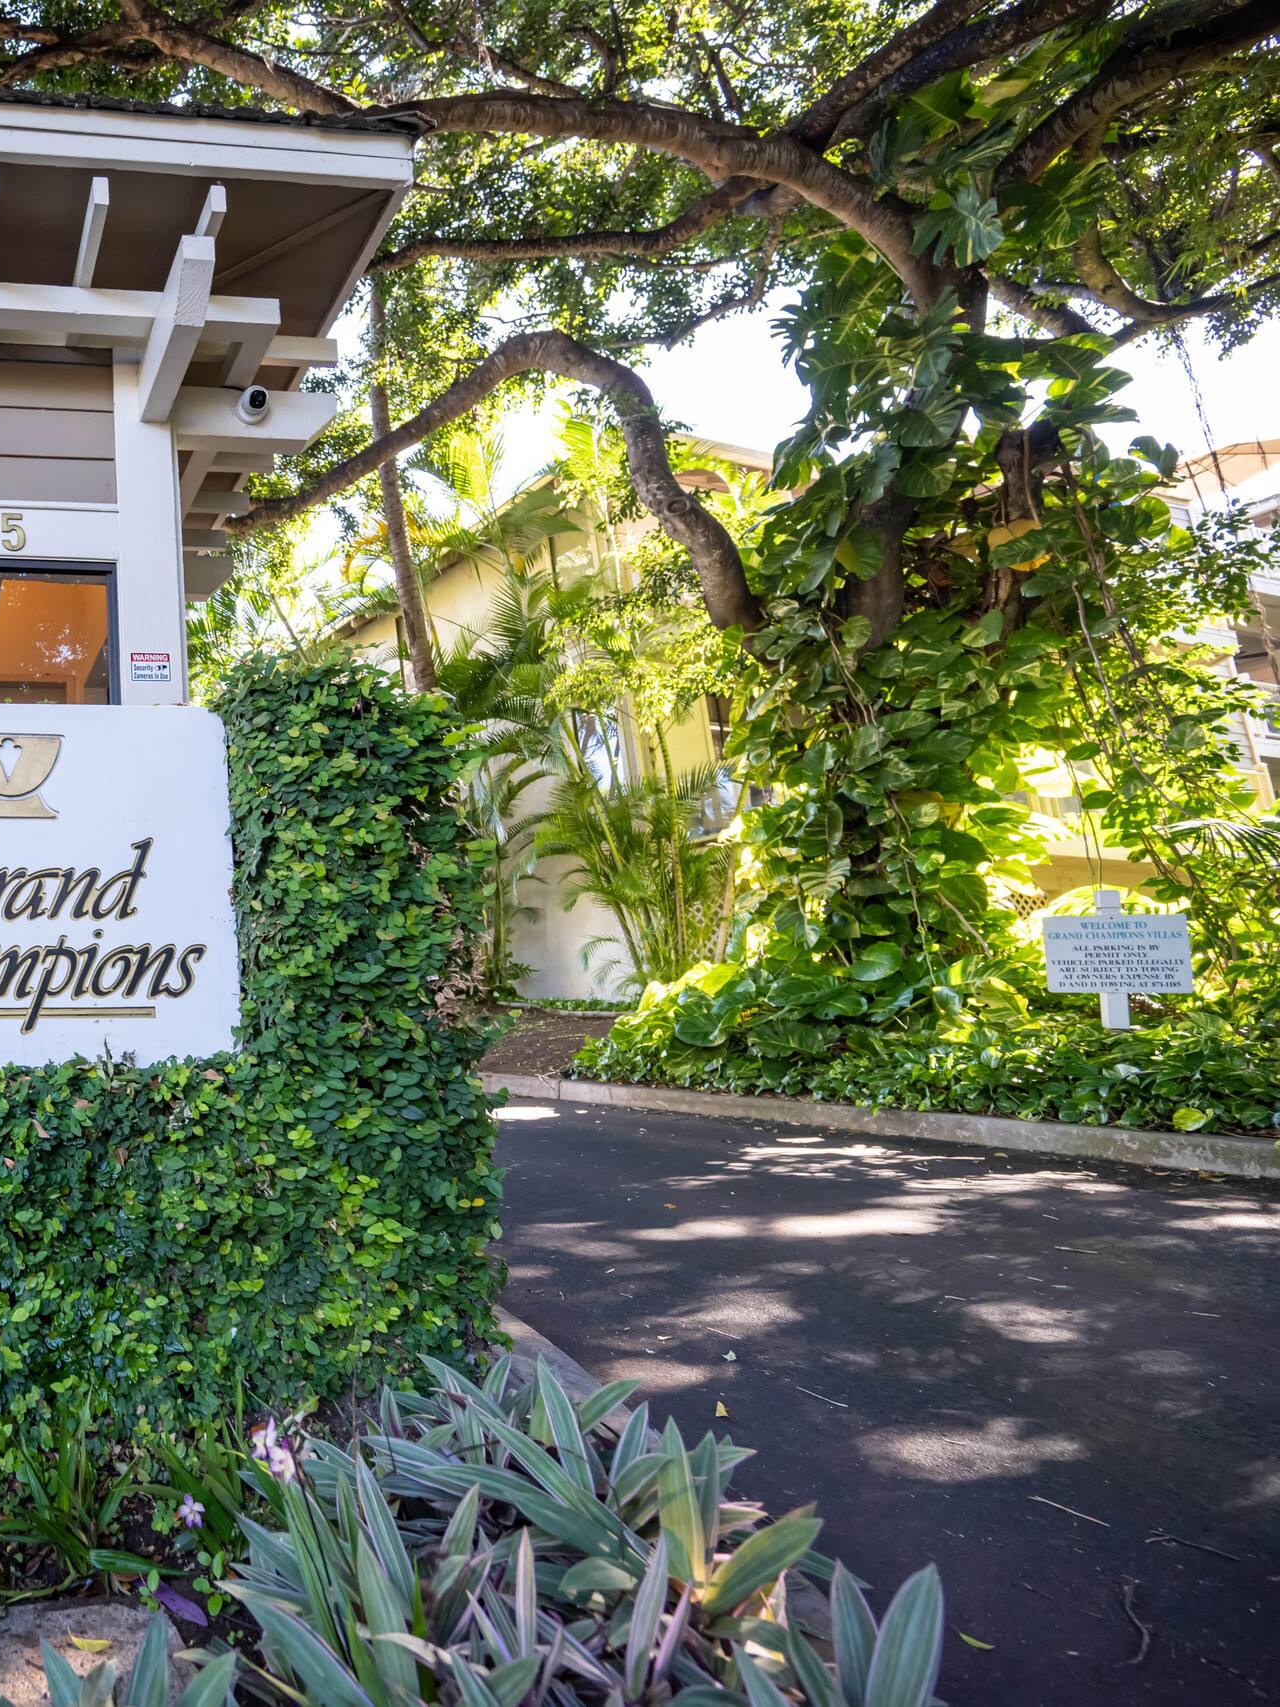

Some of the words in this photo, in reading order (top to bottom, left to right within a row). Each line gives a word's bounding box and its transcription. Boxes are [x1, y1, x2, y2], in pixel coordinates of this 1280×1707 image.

[134, 664, 153, 672] Security
[1081, 922, 1130, 930] WELCOME
[1048, 932, 1083, 940] GRAND
[1085, 931, 1145, 940] CHAMPIONS
[1147, 931, 1183, 939] VILLAS
